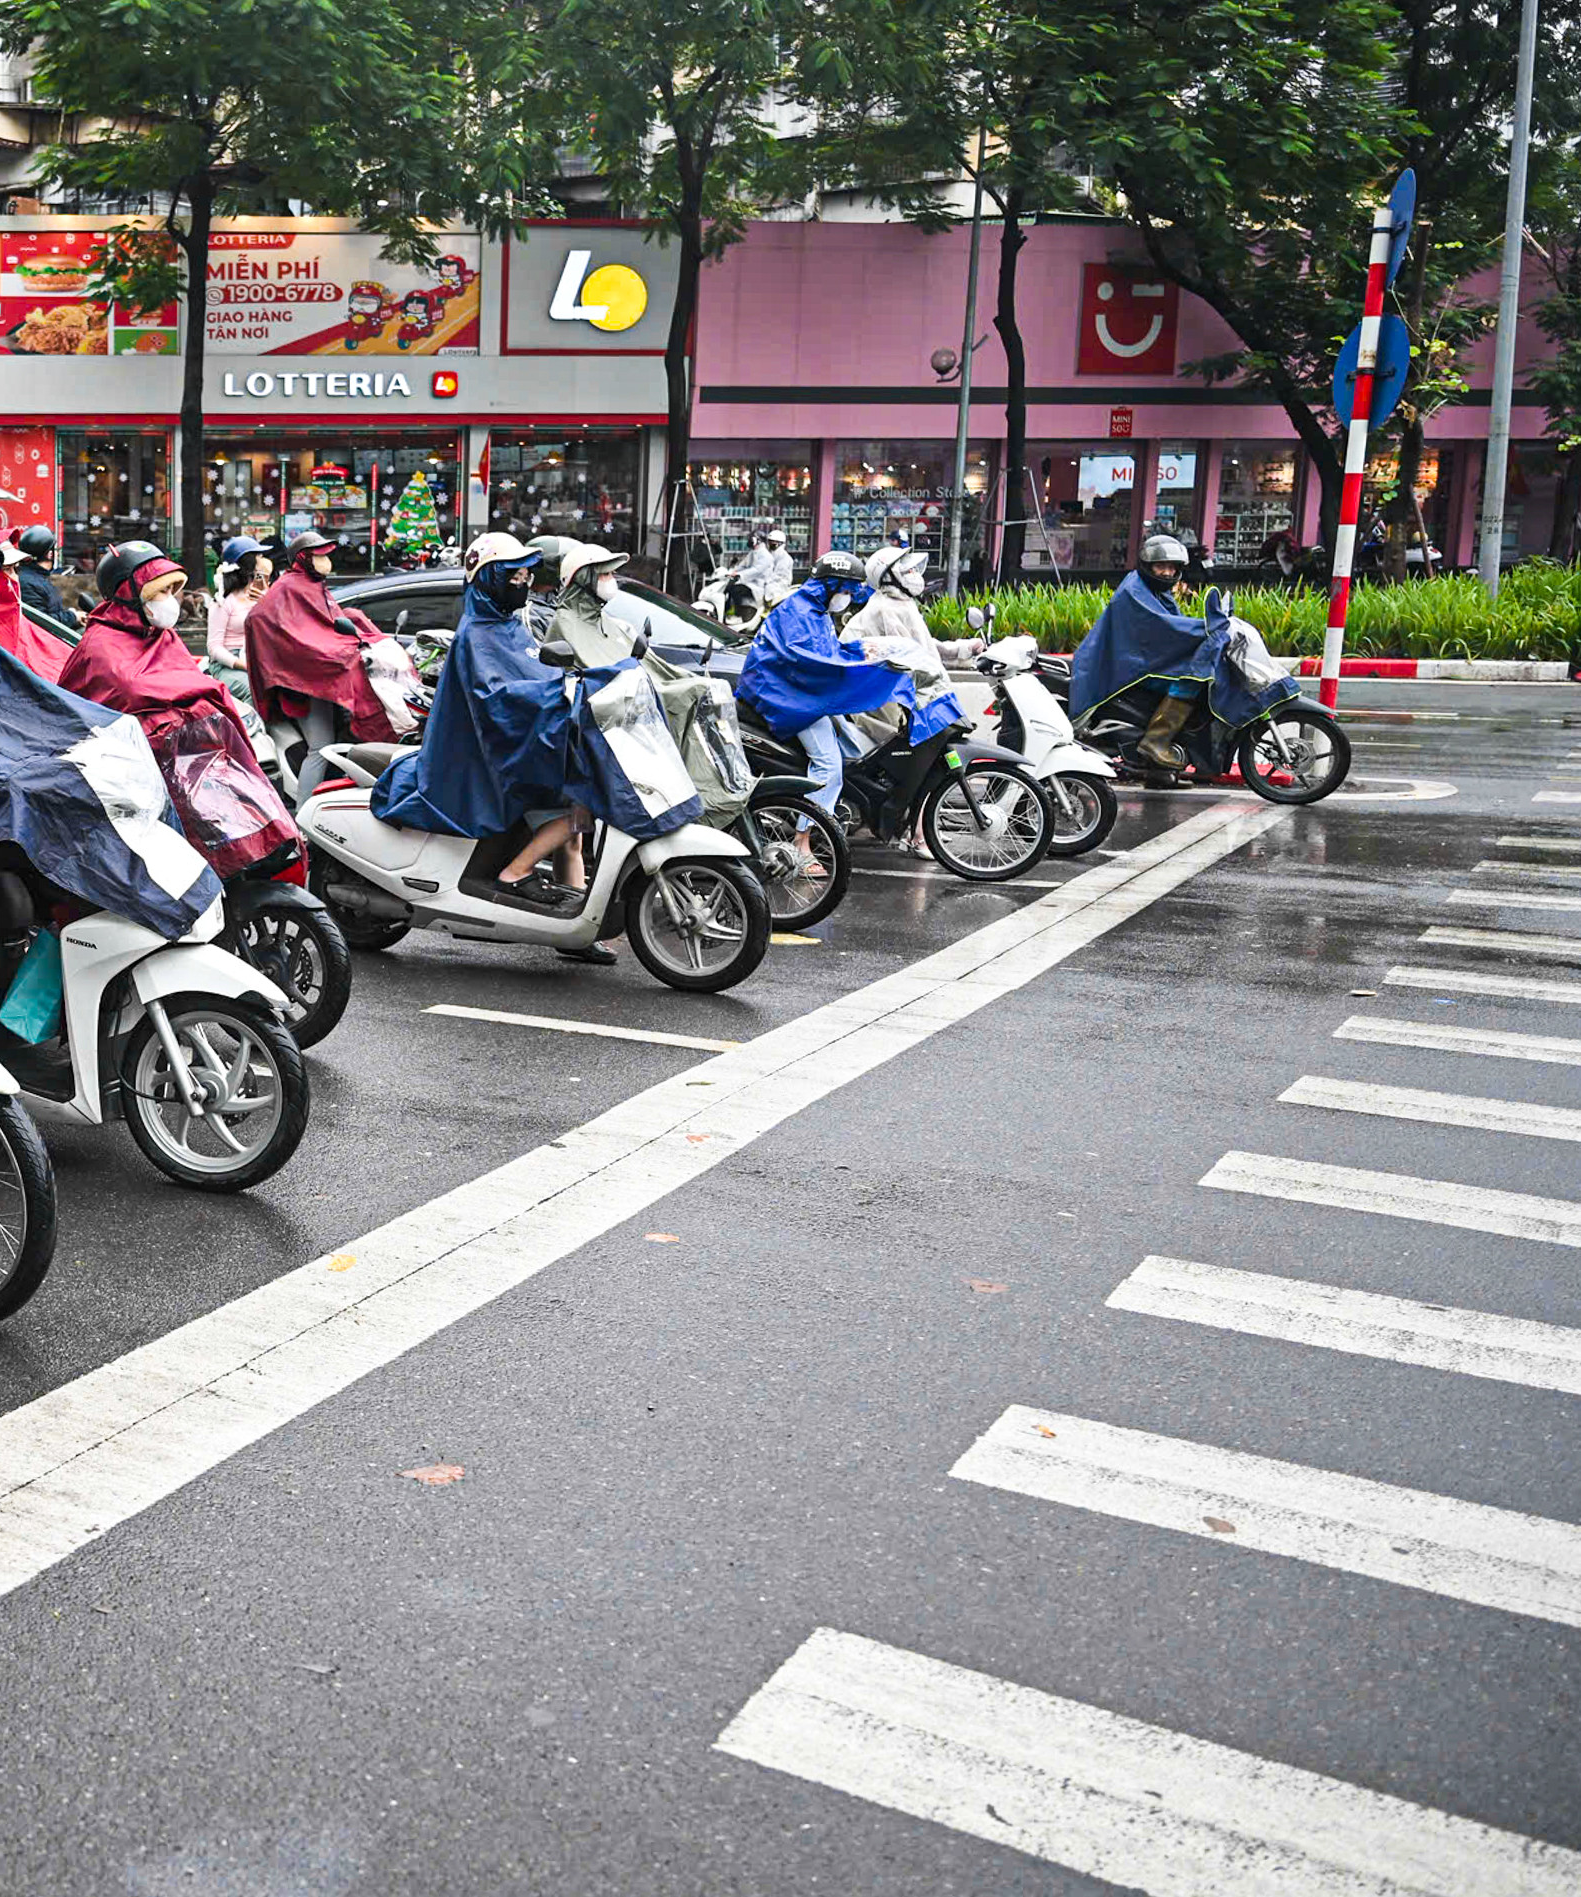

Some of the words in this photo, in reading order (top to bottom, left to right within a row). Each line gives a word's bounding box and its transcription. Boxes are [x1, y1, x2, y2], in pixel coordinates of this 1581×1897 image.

[207, 253, 268, 280] MIỄN
[277, 256, 321, 279] PHÍ
[227, 284, 336, 302] 1900-6778
[207, 311, 244, 323] GIAO
[249, 308, 293, 322] HÀNG
[207, 326, 237, 342] TẬN
[242, 327, 269, 339] NƠI
[224, 372, 411, 397] LOTTERIA
[1112, 415, 1131, 423] MINI
[869, 486, 930, 499] Collection
[66, 936, 98, 950] HONDA
